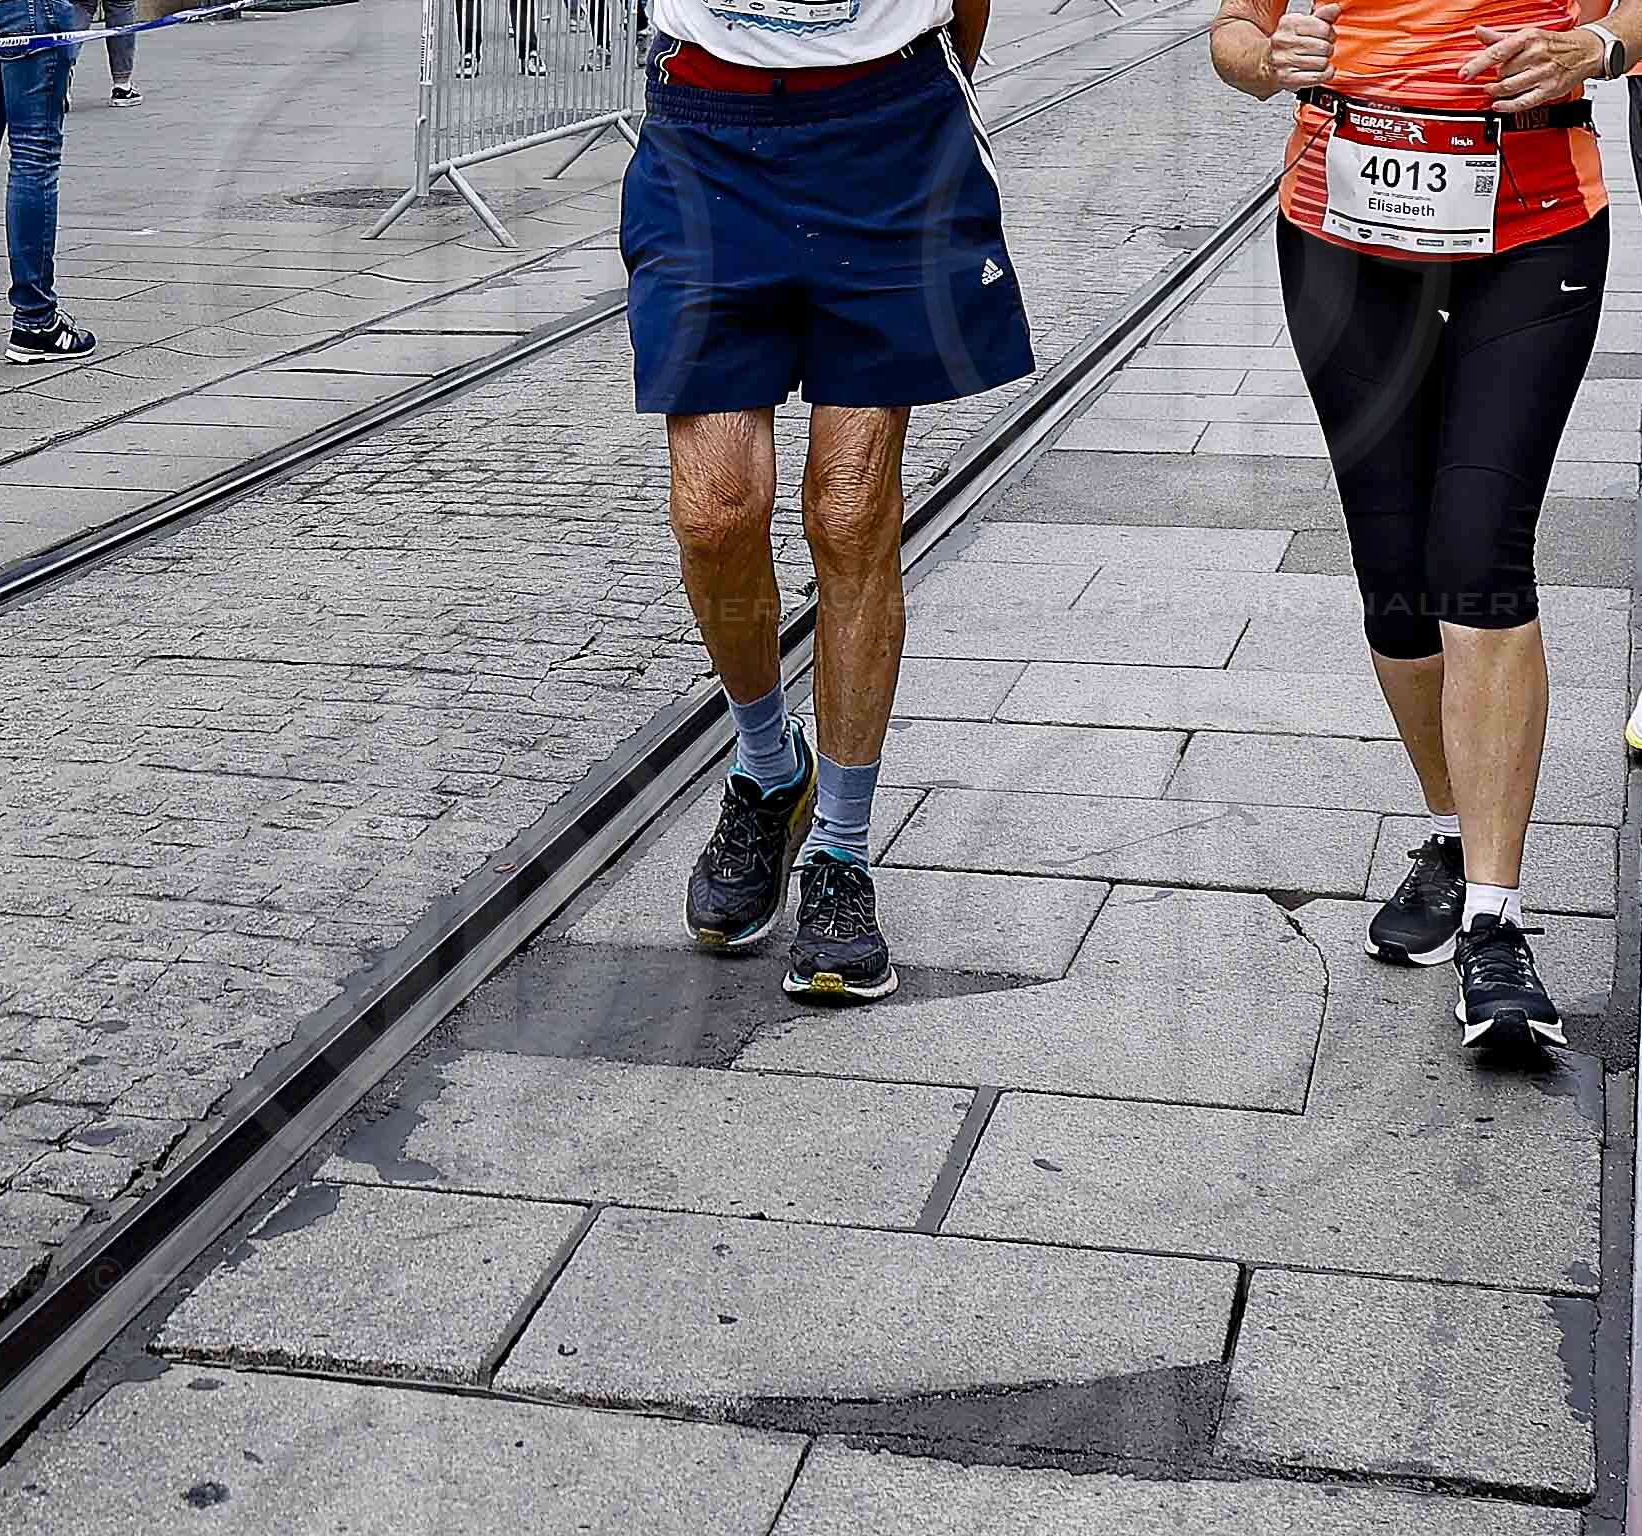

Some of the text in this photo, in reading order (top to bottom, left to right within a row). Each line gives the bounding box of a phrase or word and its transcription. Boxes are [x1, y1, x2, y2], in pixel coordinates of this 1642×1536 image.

[1360, 115, 1394, 130] GRAZ
[1360, 155, 1448, 194] 4013
[1367, 197, 1436, 217] Elisabeth
